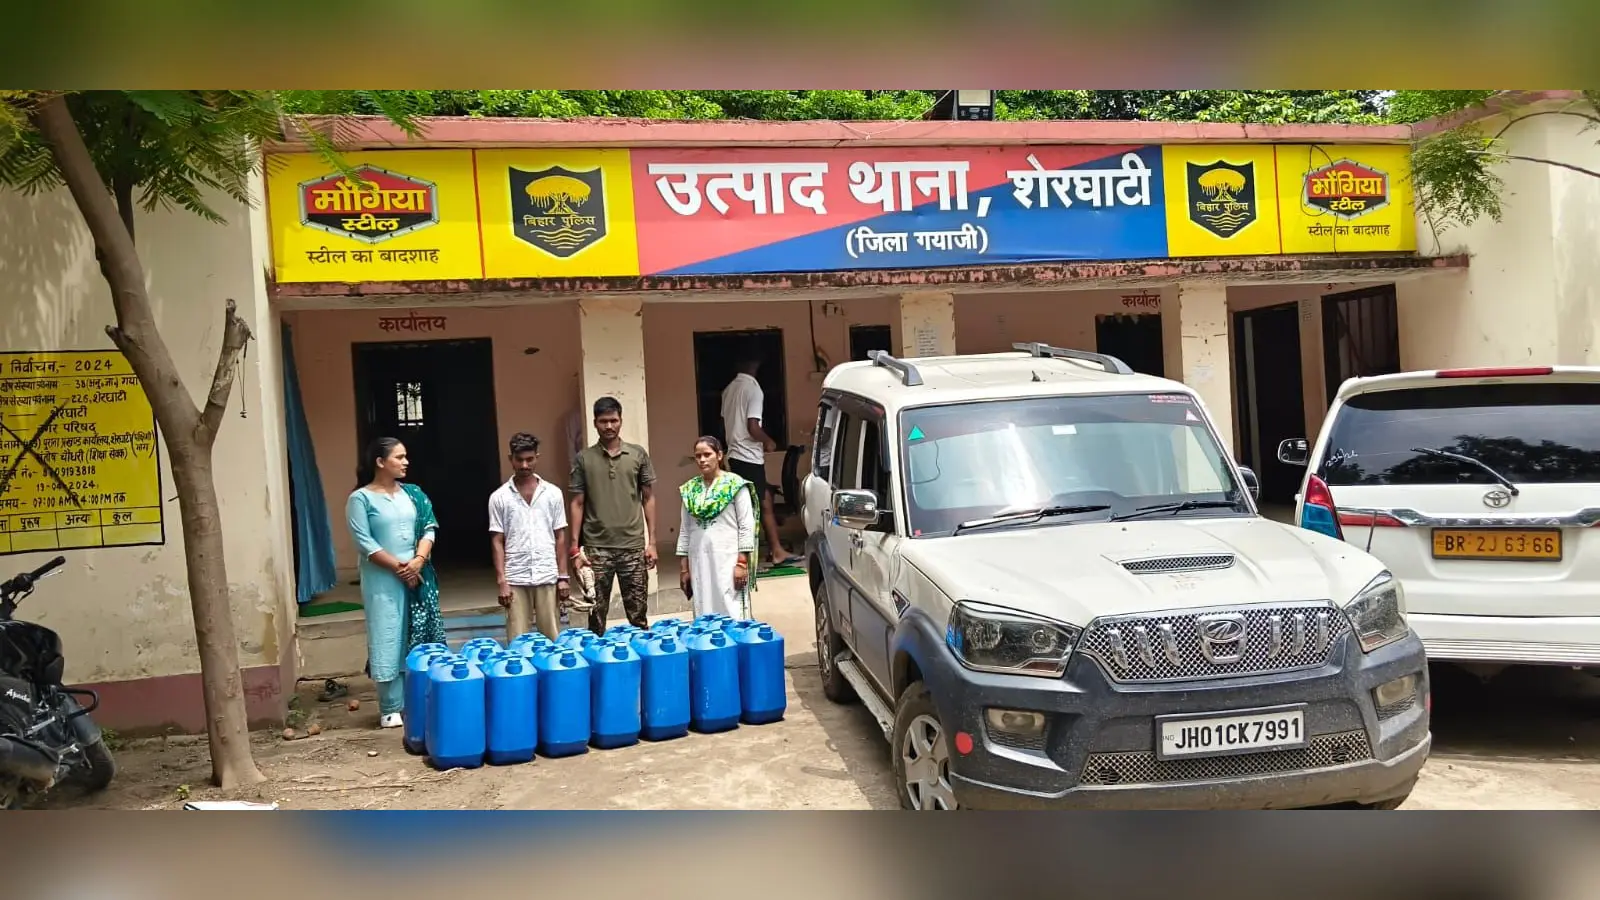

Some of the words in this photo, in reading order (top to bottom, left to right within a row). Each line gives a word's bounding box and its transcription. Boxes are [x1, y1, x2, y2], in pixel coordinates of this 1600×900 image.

[648, 161, 828, 217] उत्पाद
[1007, 152, 1152, 209] शेरघाटी
[1196, 201, 1220, 213] बिहार
[1224, 201, 1249, 214] पुलिस
[1328, 199, 1366, 211] स्टील
[341, 213, 400, 232] स्टील
[523, 215, 555, 227] बिहार
[562, 215, 595, 229] पुलिस
[1307, 223, 1333, 236] स्टील
[1335, 225, 1349, 236] का
[1353, 223, 1390, 236] बादशाह
[845, 227, 908, 259] (जिला
[916, 222, 989, 255] गयाजी)
[306, 247, 346, 265] स्टील
[353, 249, 373, 264] का
[380, 247, 440, 264] बादशाह
[1120, 289, 1161, 308] कार्याल
[378, 310, 447, 332] कार्यालय
[75, 359, 112, 371] 2024
[1175, 717, 1300, 749] JH01CK7991
